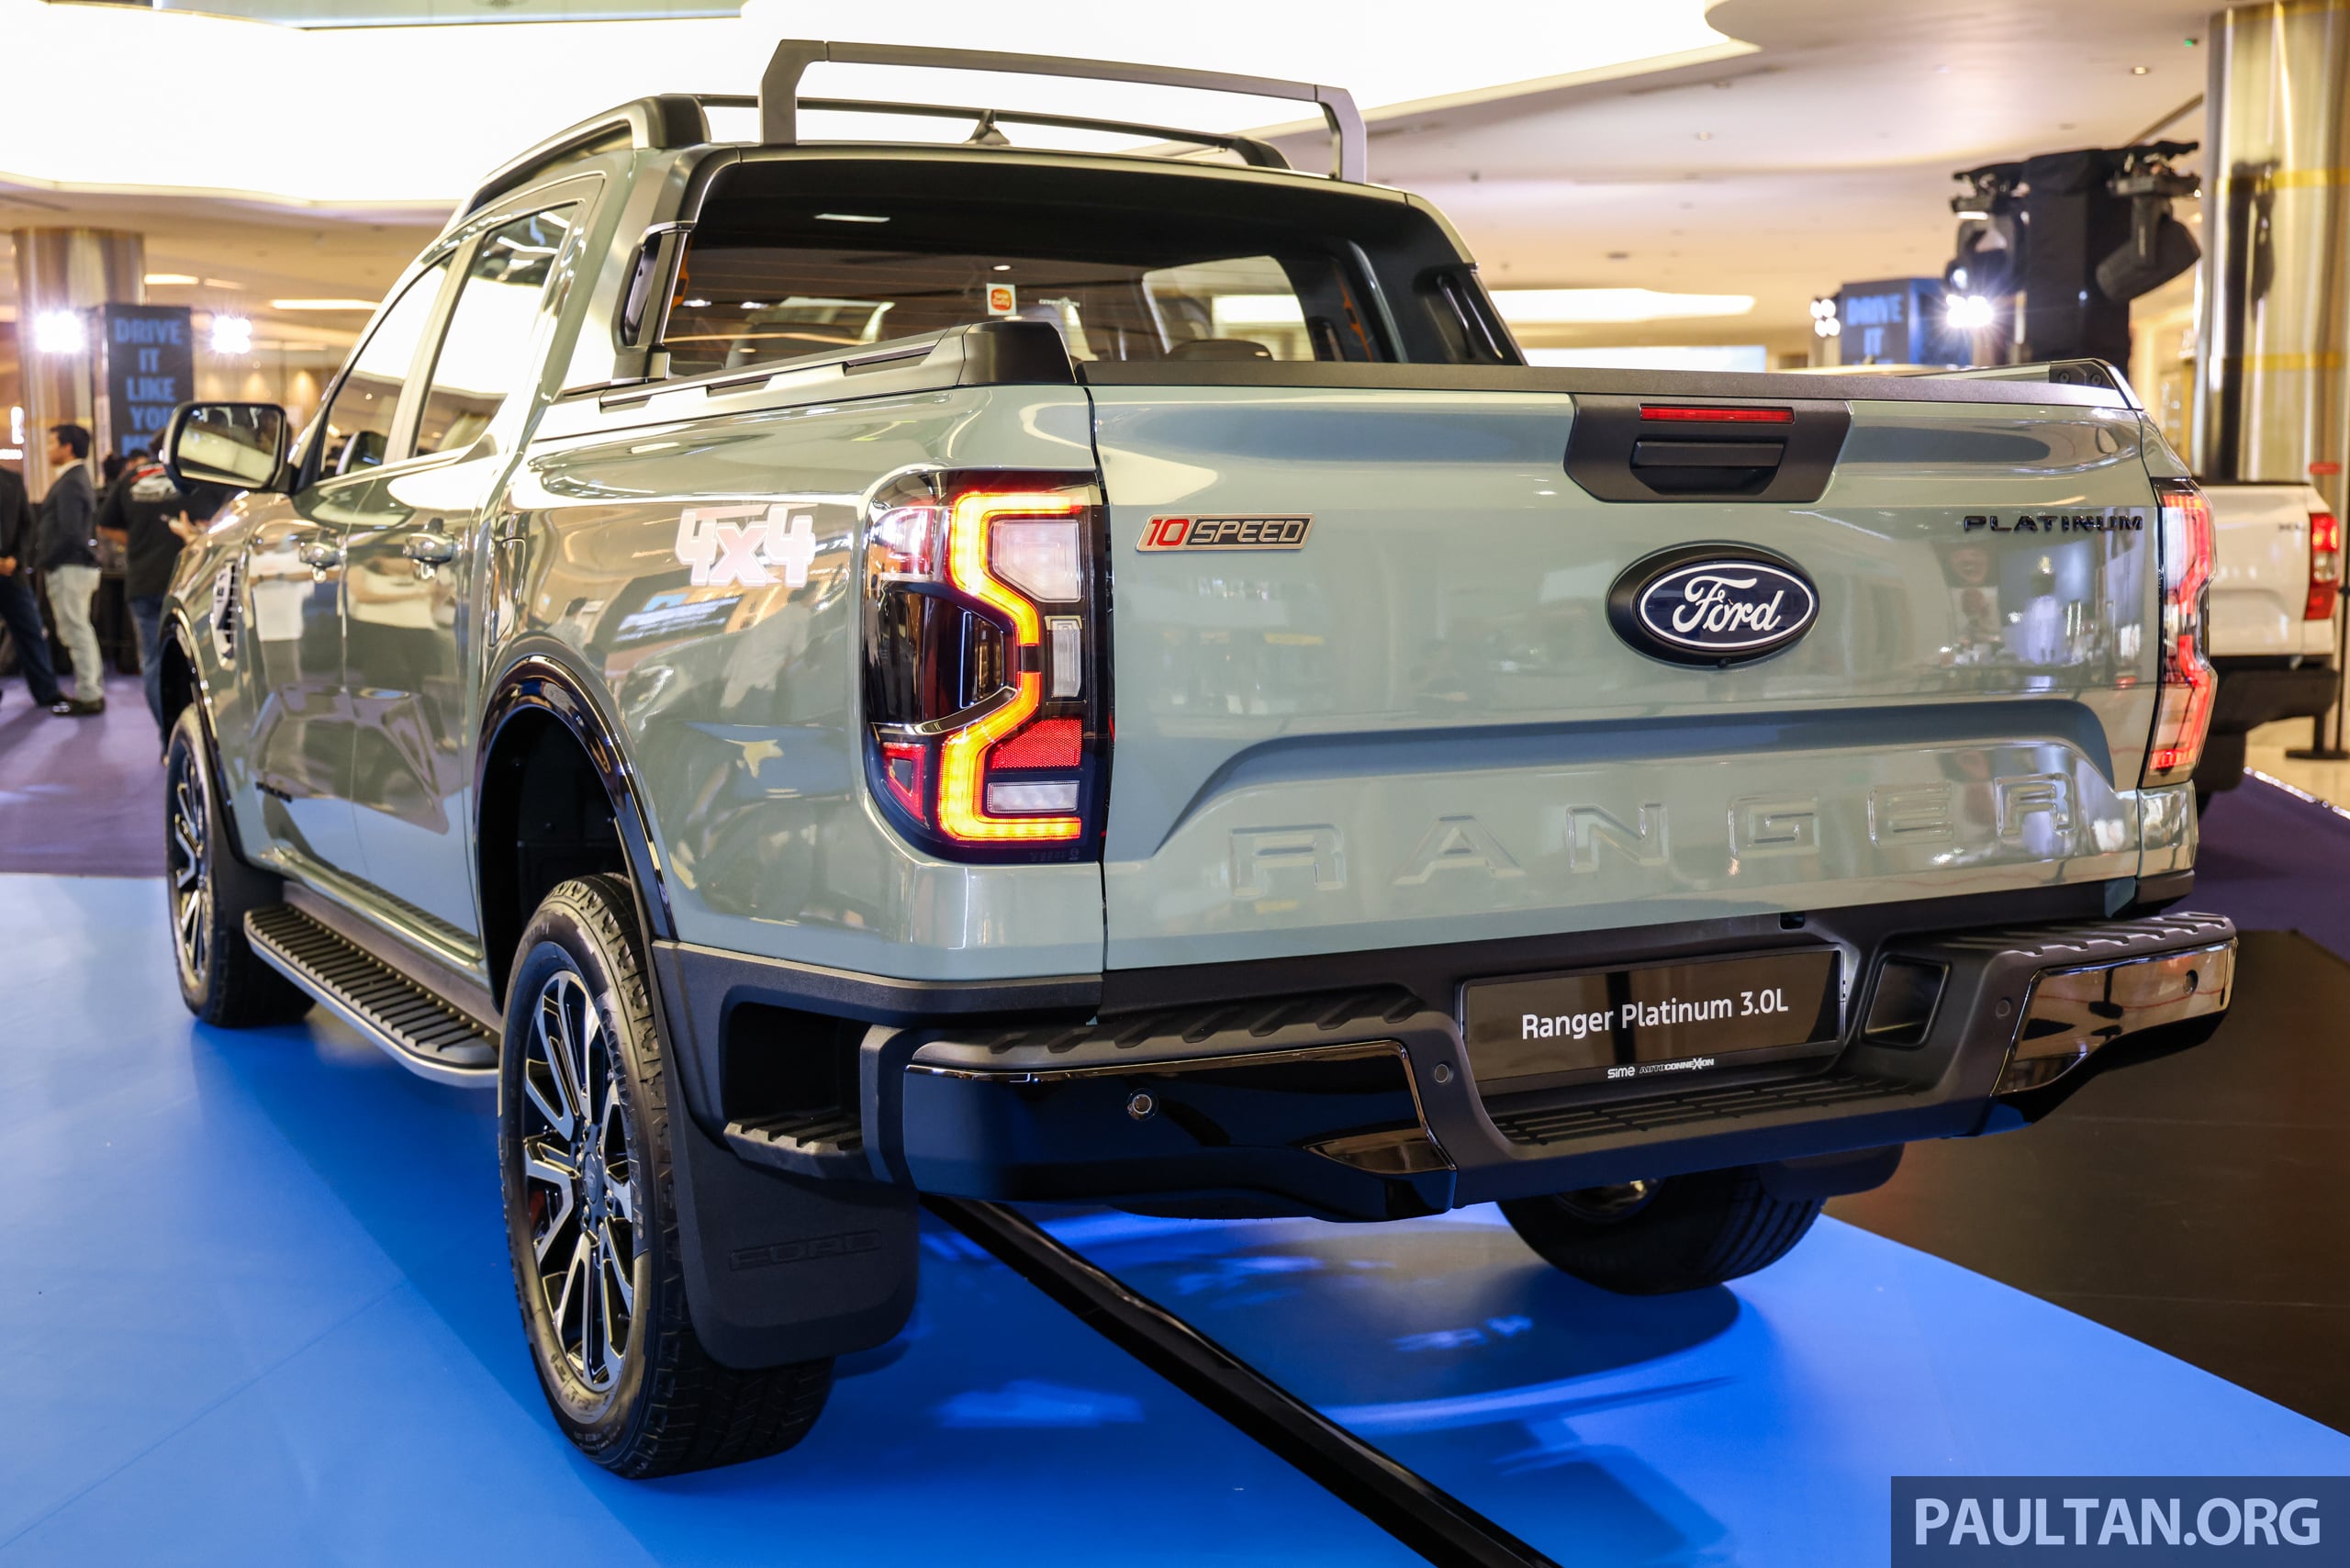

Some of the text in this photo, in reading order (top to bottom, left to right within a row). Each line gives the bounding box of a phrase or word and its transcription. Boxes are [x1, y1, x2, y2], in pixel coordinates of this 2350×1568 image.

[1846, 293, 1904, 326] DRIVE
[114, 318, 184, 345] DRIVE
[1863, 327, 1885, 356] IT
[139, 347, 161, 373] IT
[126, 376, 176, 402] LIKE
[1963, 515, 2143, 532] PLATINUM
[1672, 575, 1785, 633] Ford
[1228, 772, 2076, 899] RANGER
[1521, 988, 1789, 1040] Ranger Platinum 3.0L
[729, 1228, 882, 1271] FORD
